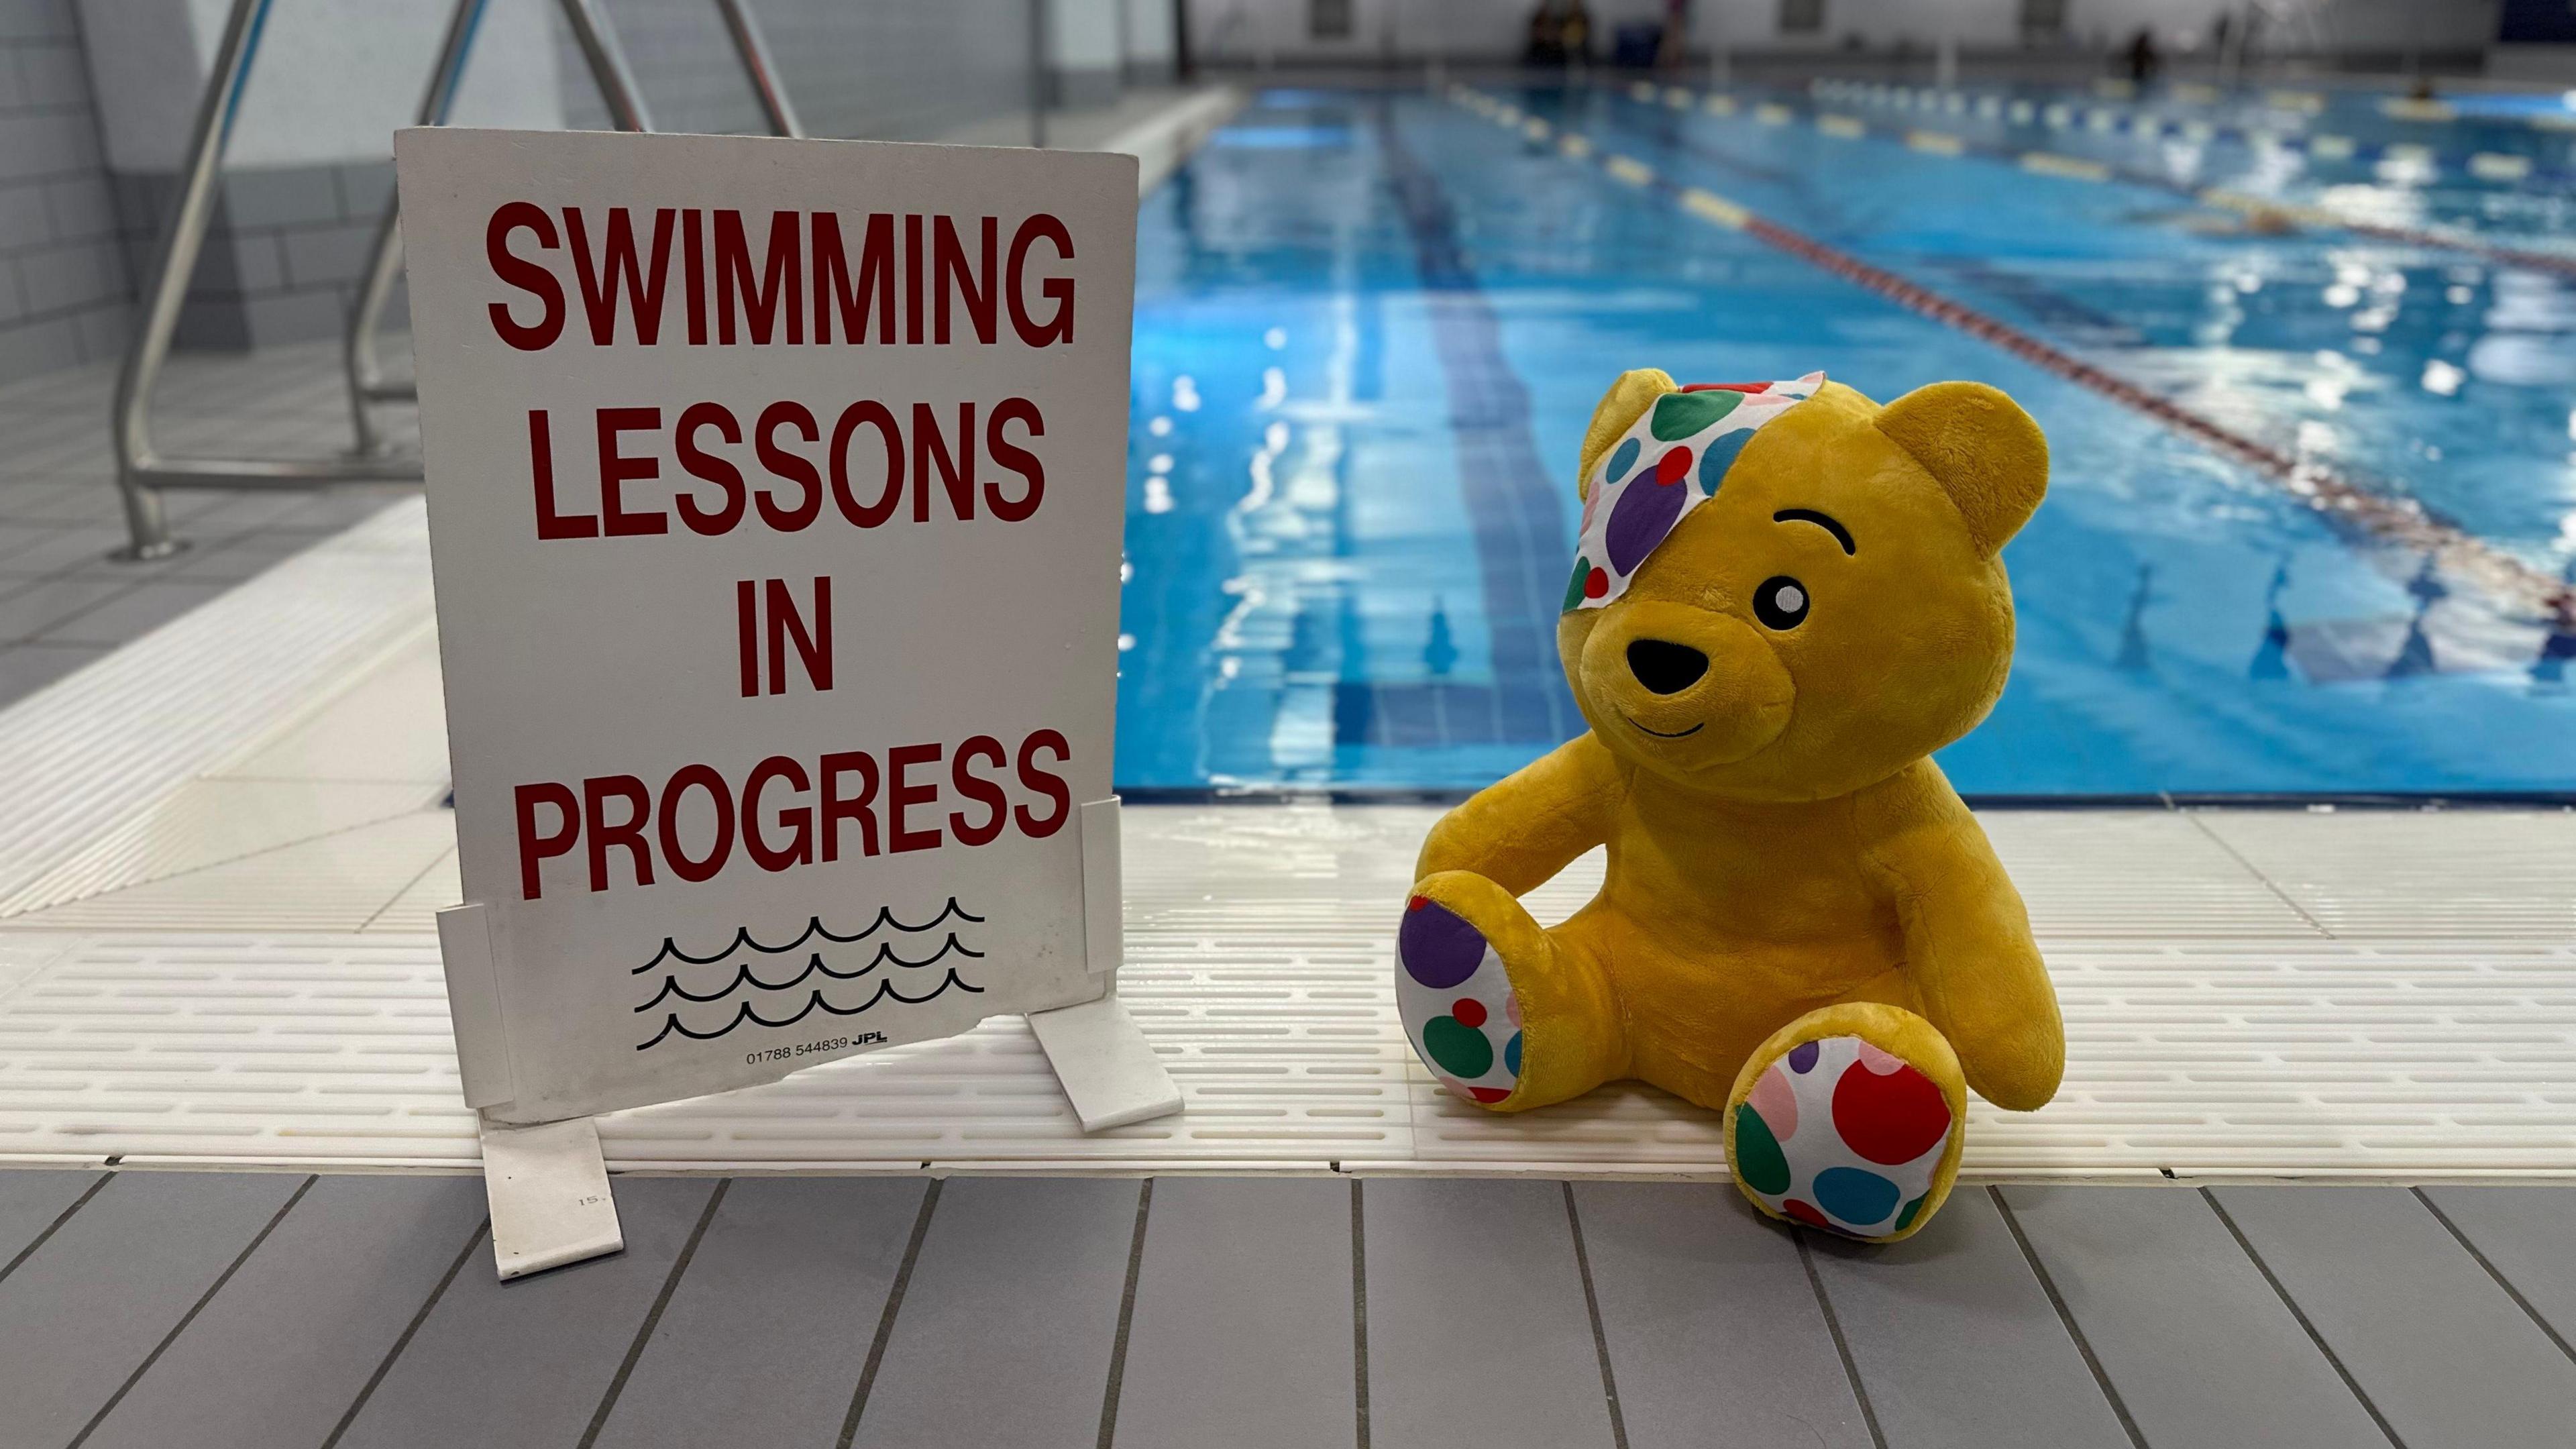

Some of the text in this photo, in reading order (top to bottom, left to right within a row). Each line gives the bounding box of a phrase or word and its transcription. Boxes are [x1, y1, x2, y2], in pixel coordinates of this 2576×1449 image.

[487, 201, 1076, 350] SWIMMING
[529, 397, 1044, 539] LESSONS
[737, 577, 833, 696] IN
[514, 729, 1071, 900] PROGRESS
[746, 1031, 888, 1065] 01788 544839 JPL
